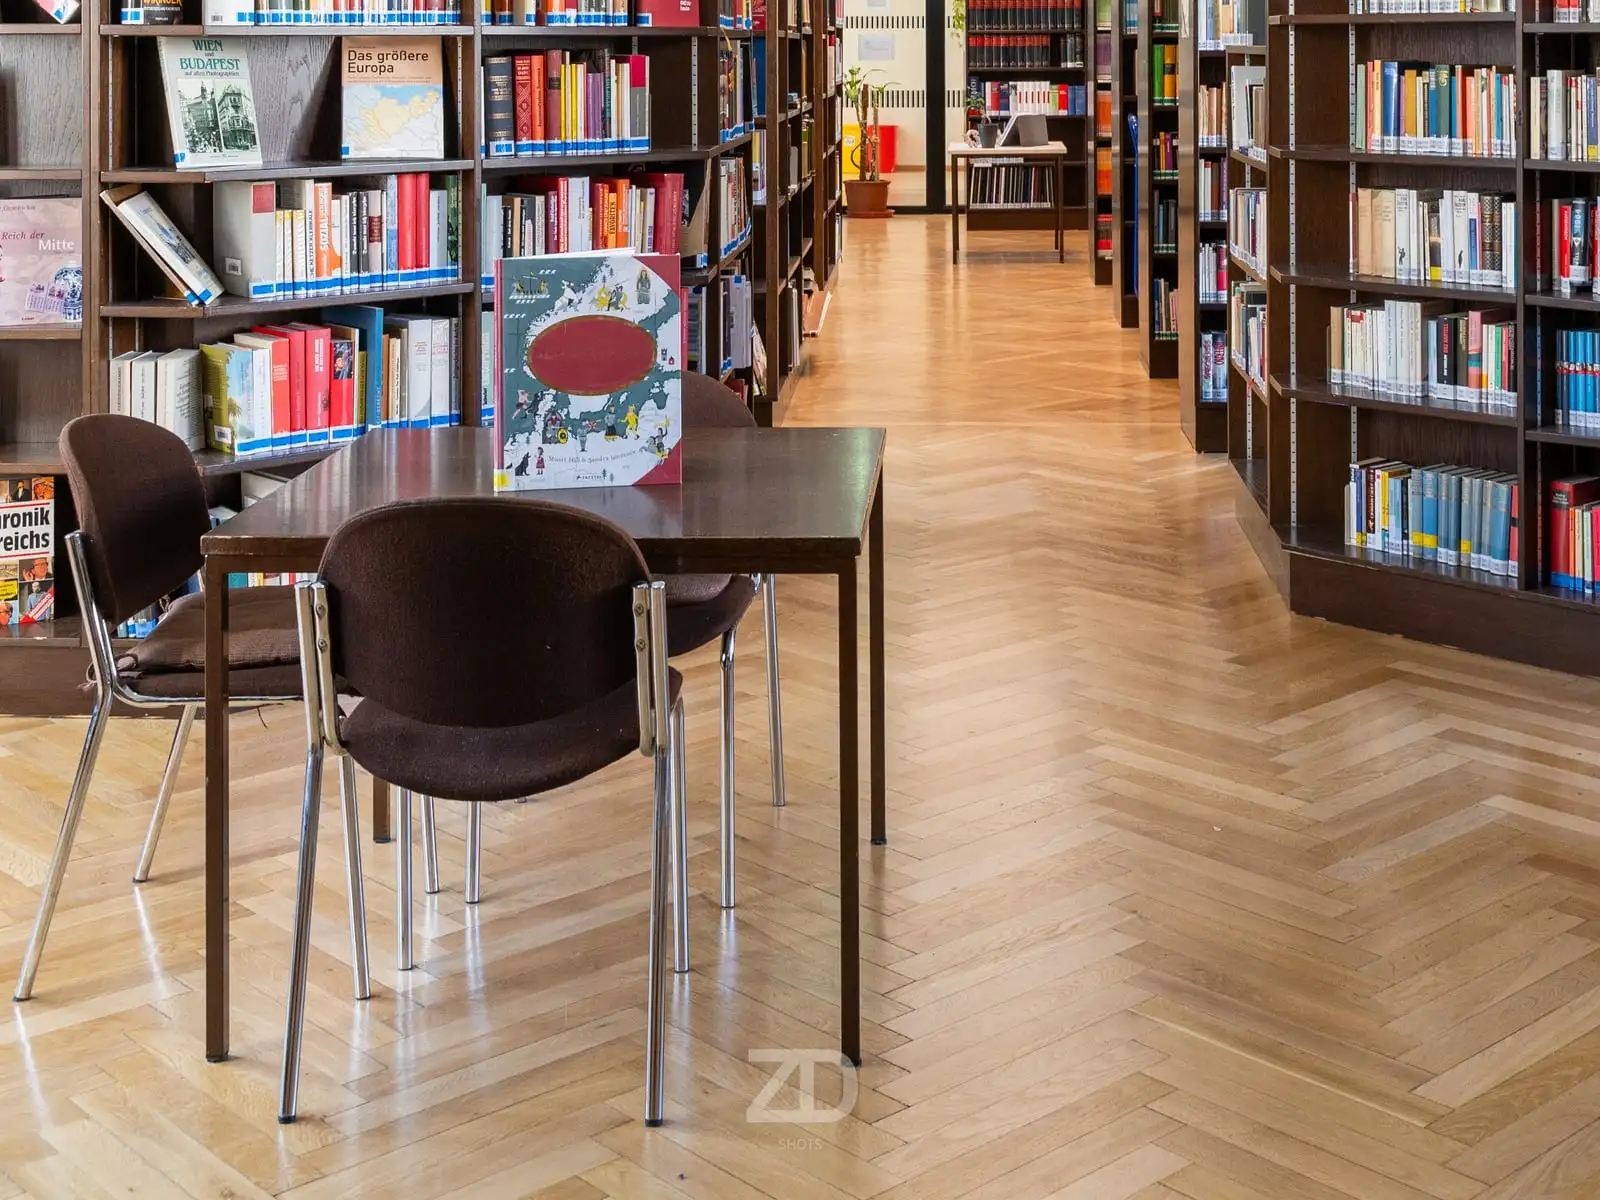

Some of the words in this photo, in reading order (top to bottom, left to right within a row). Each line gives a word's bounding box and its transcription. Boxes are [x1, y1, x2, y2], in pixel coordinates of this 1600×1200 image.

[192, 39, 224, 51] WIEN
[348, 50, 373, 61] Das
[377, 50, 429, 64] größere
[180, 58, 240, 70] BUDAPEST
[348, 62, 394, 75] Europa
[1, 232, 26, 240] Reich
[30, 230, 45, 239] der
[38, 238, 75, 251] Mitte
[0, 507, 50, 535] ronik
[0, 530, 50, 551] eichs
